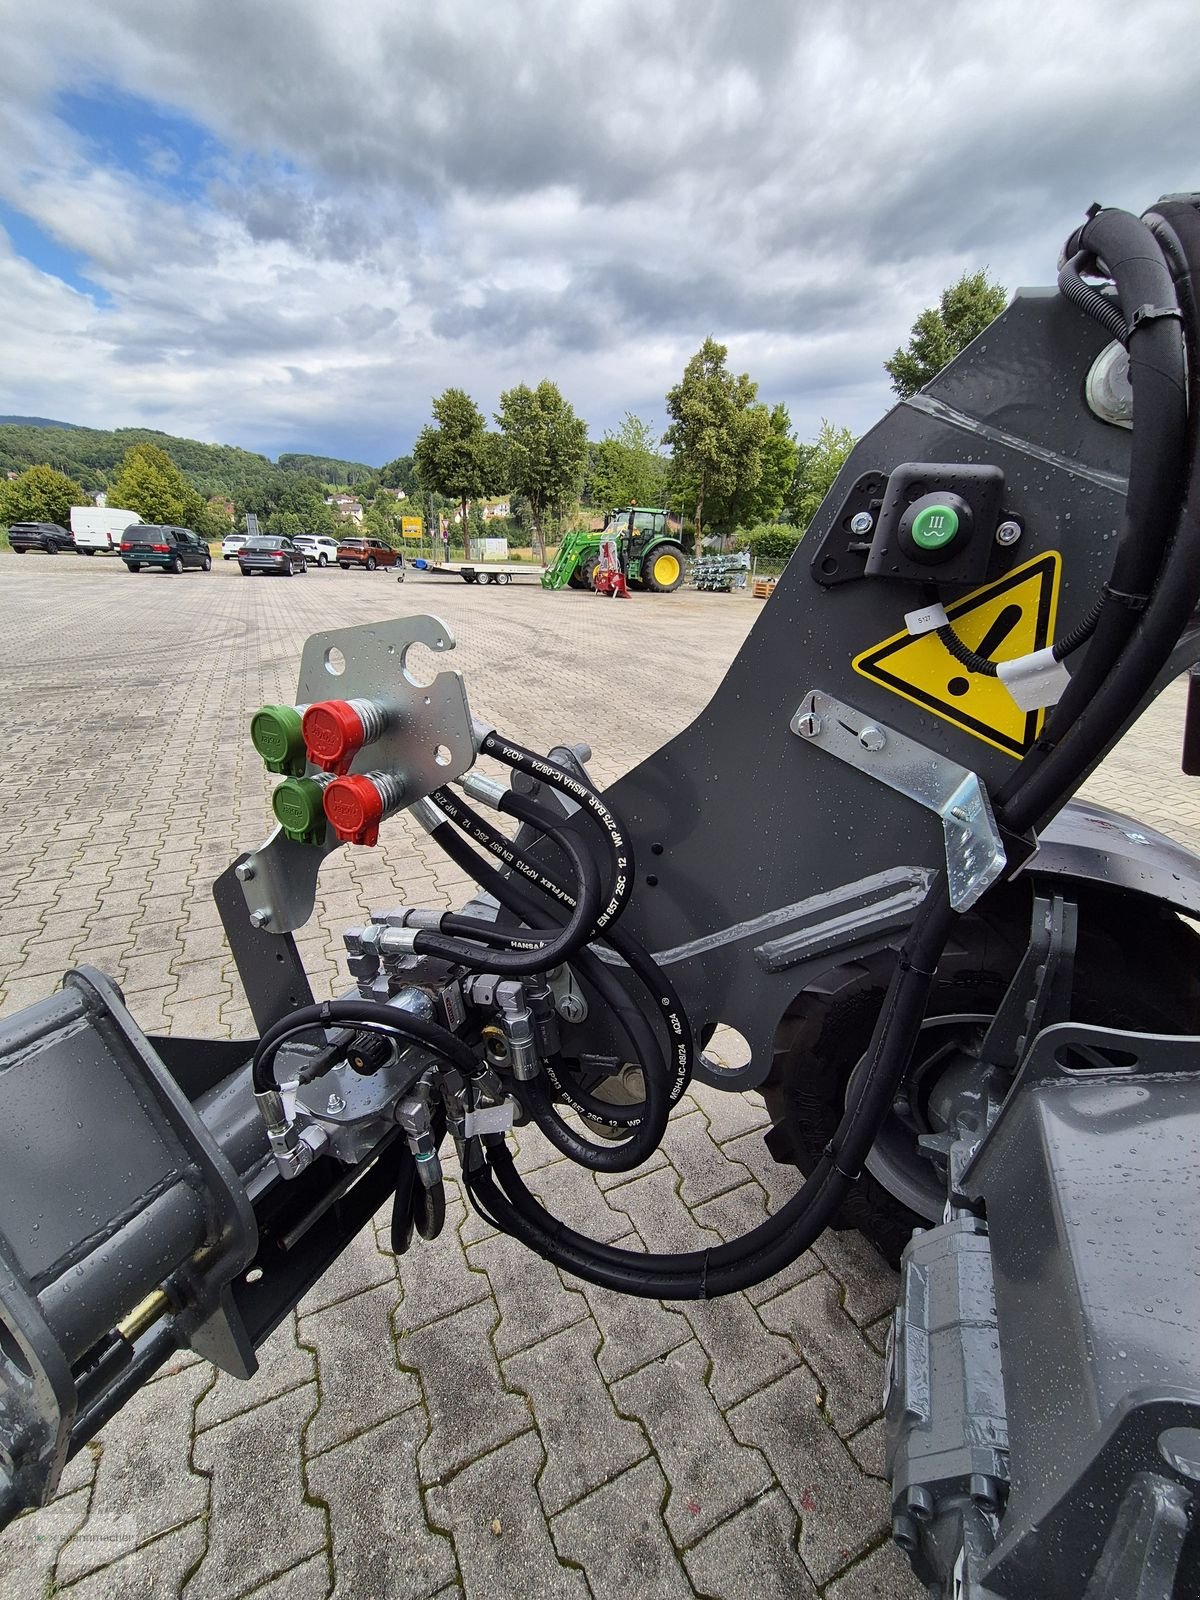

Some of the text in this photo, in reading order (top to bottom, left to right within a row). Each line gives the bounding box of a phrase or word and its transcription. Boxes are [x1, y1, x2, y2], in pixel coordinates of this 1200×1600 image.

[502, 746, 524, 762] 4Q24
[562, 776, 588, 798] MSHA
[433, 792, 447, 806] 275
[588, 796, 607, 816] BAR
[444, 804, 458, 817] WP
[461, 818, 472, 829] 12
[602, 814, 617, 831] 275
[473, 828, 490, 843] 2SC
[611, 831, 623, 848] WP
[489, 841, 503, 854] 857
[501, 849, 514, 862] EN
[515, 860, 539, 880] KP213
[617, 856, 627, 869] 12
[615, 875, 627, 896] 2SC
[606, 897, 620, 915] 857
[597, 913, 610, 927] EN
[669, 1013, 682, 1035] 4Q24
[546, 1067, 562, 1090] KP213
[561, 1092, 573, 1104] EN
[626, 1119, 641, 1127] WP
[669, 1077, 685, 1100] MSHA
